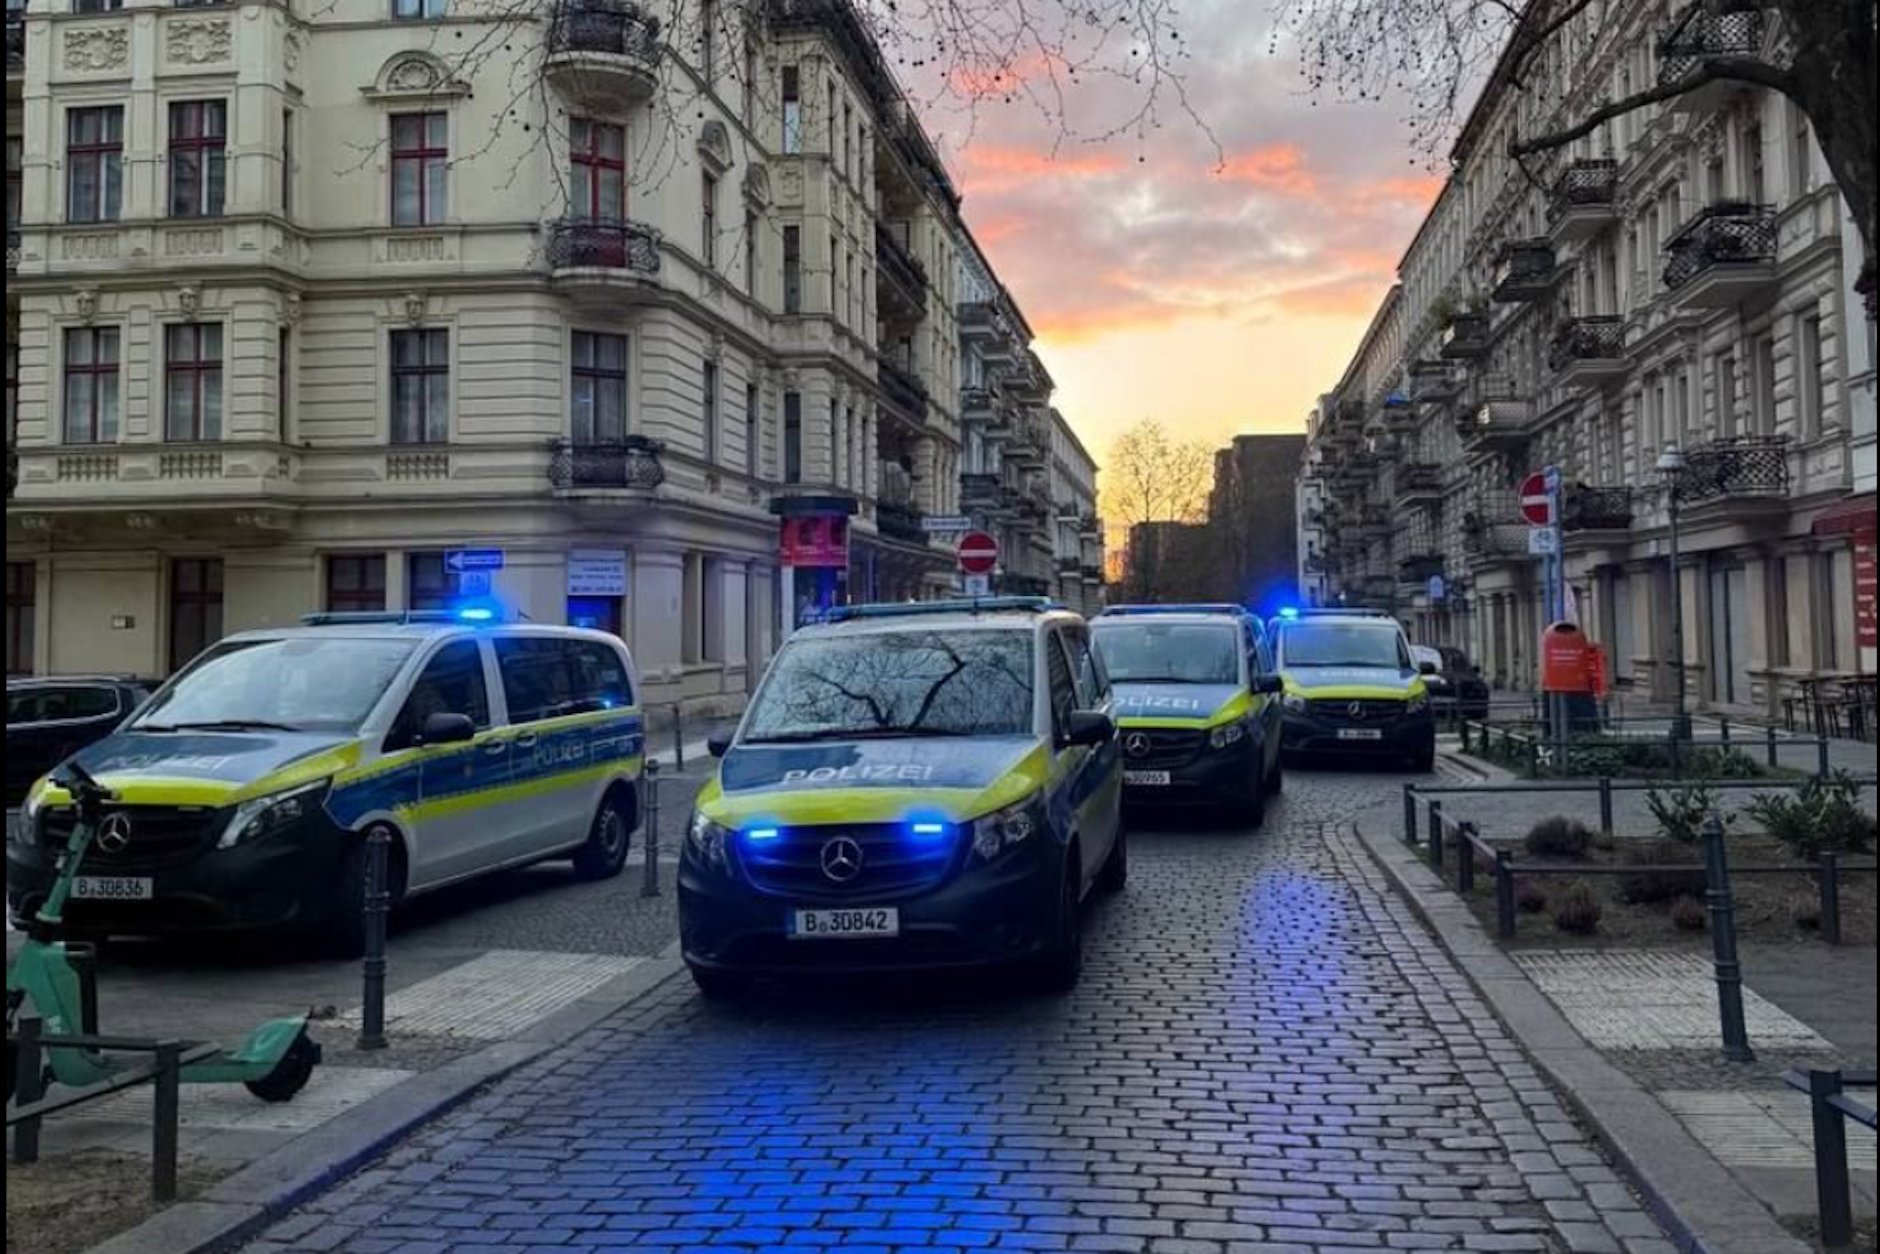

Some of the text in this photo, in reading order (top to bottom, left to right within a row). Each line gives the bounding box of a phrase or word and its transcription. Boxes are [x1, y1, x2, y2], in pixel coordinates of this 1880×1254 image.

[784, 764, 933, 782] POLIZEI
[805, 910, 888, 932] B 30842
